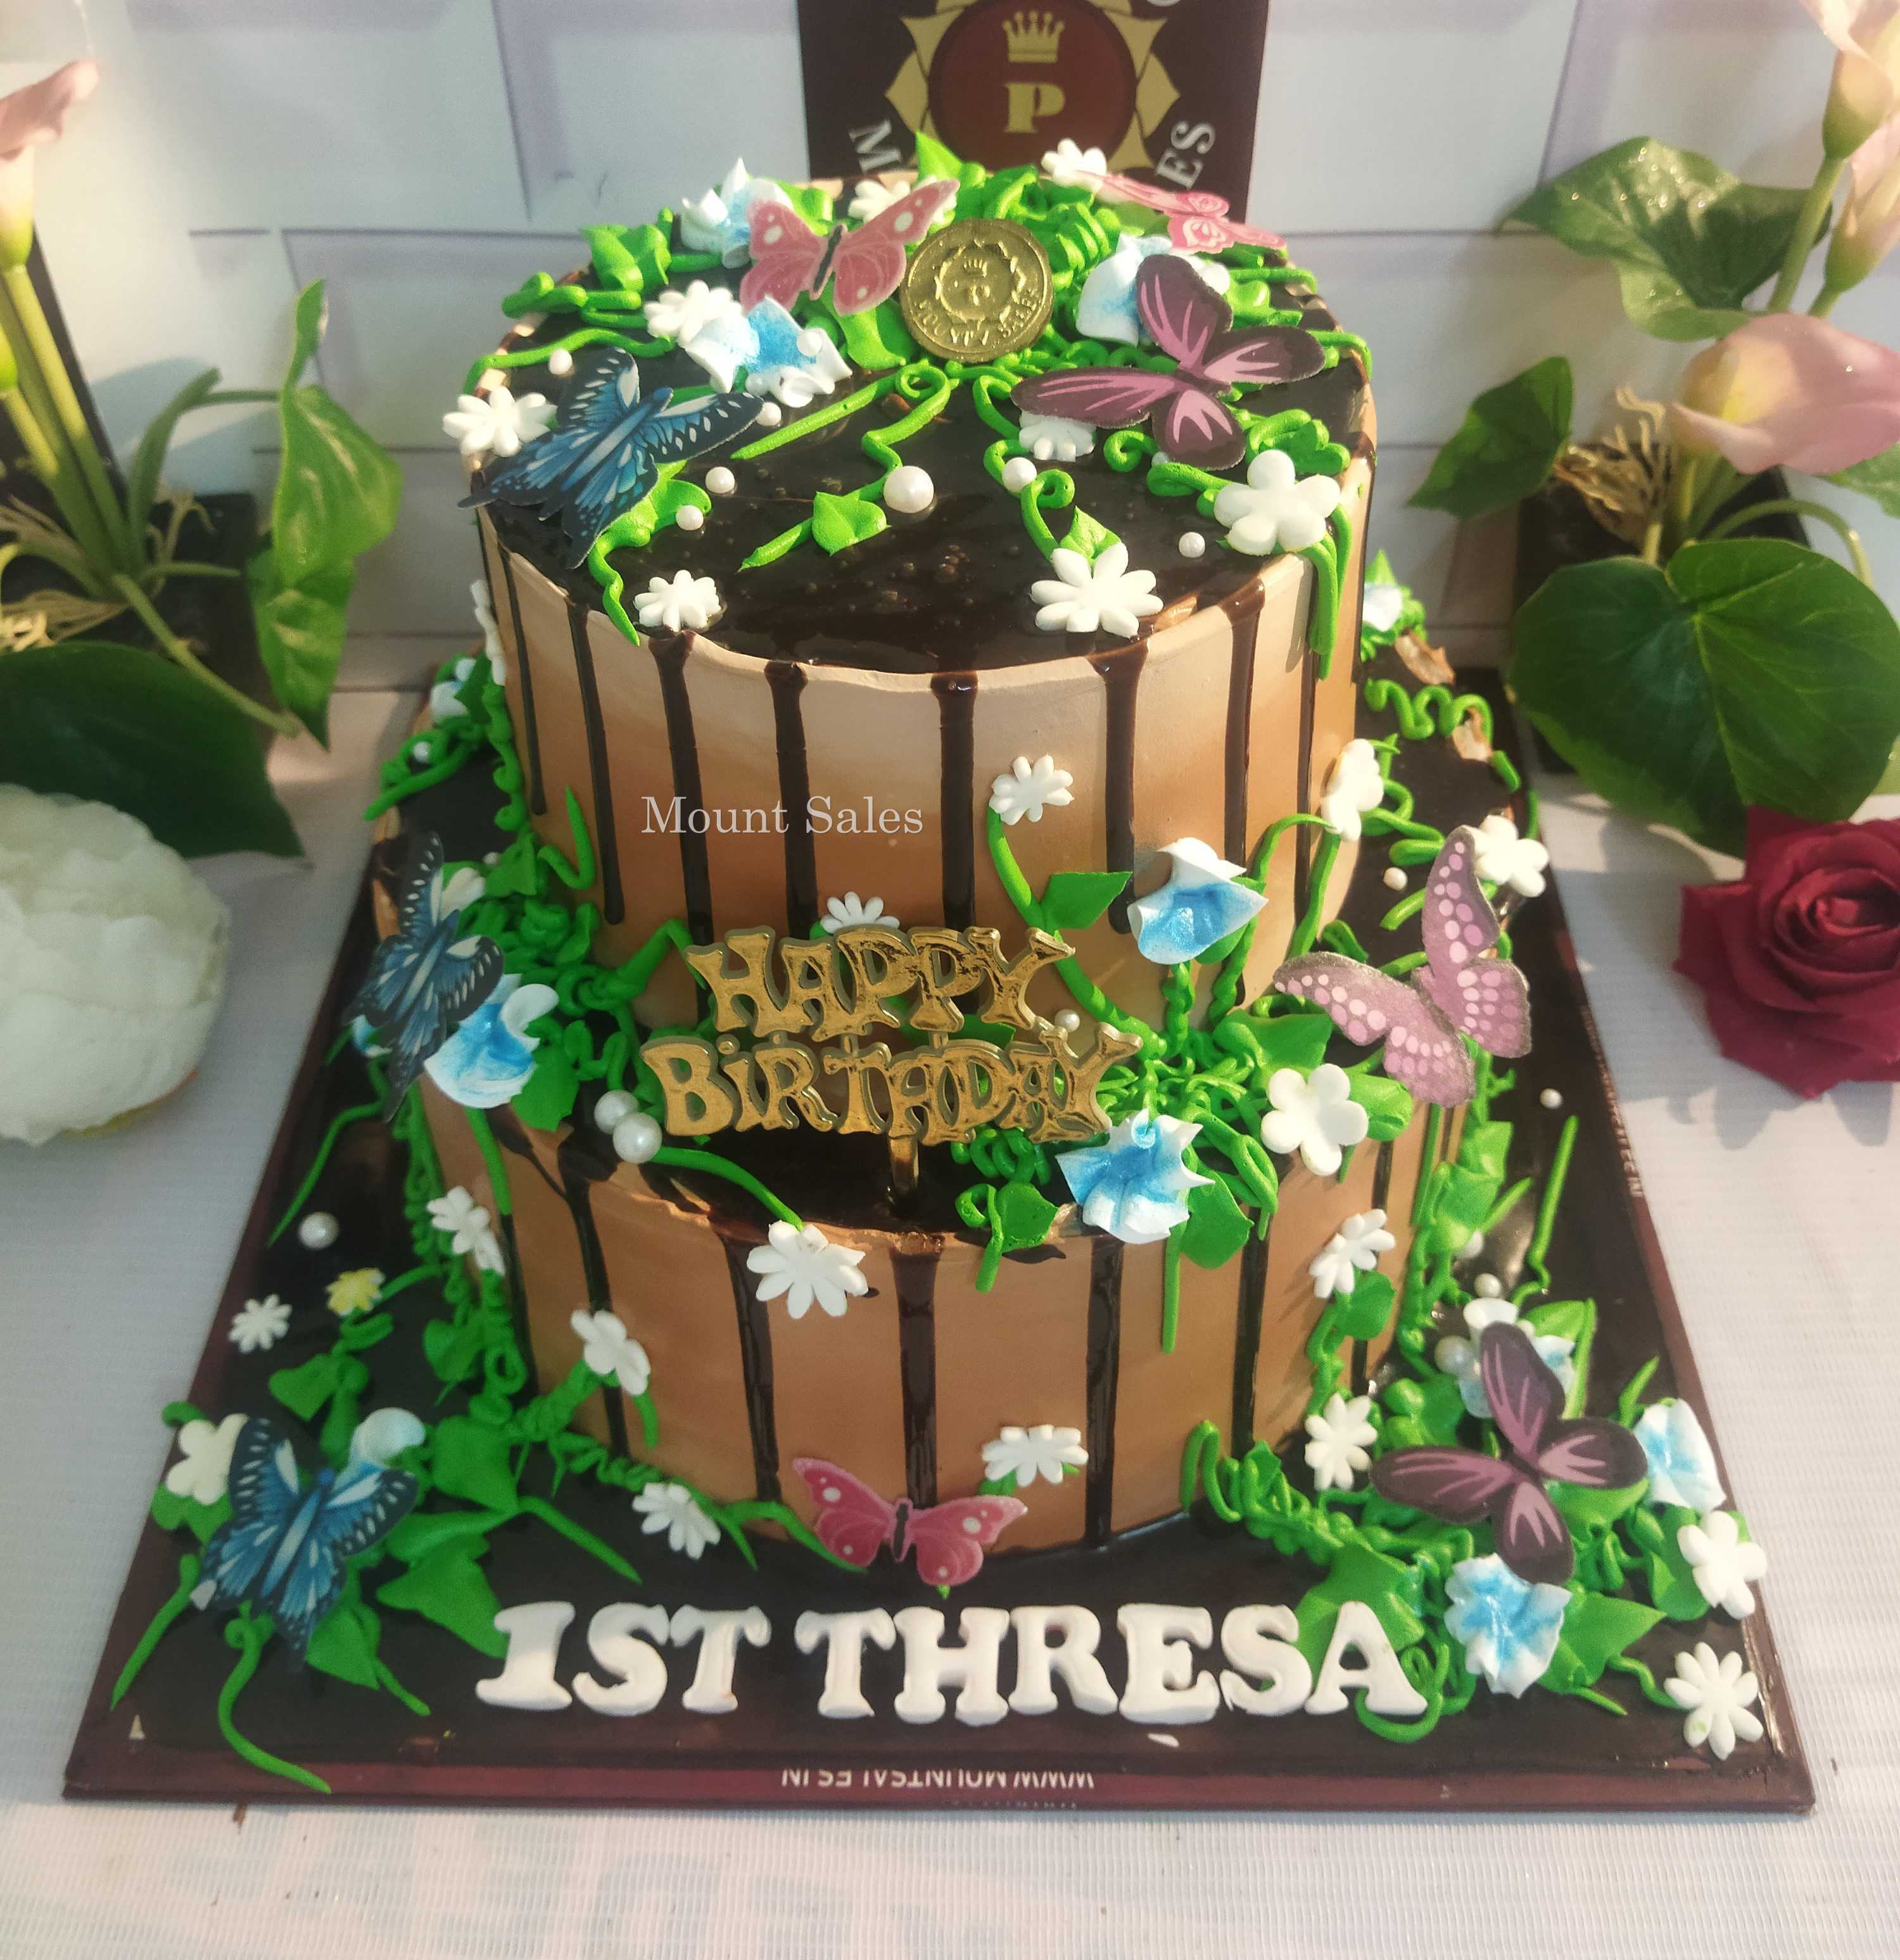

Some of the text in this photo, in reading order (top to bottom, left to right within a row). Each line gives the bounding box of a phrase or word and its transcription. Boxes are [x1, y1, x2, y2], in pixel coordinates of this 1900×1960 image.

[1003, 82, 1065, 133] P
[685, 926, 1075, 1039] HAPPY
[794, 1602, 1428, 1724] THRESA
